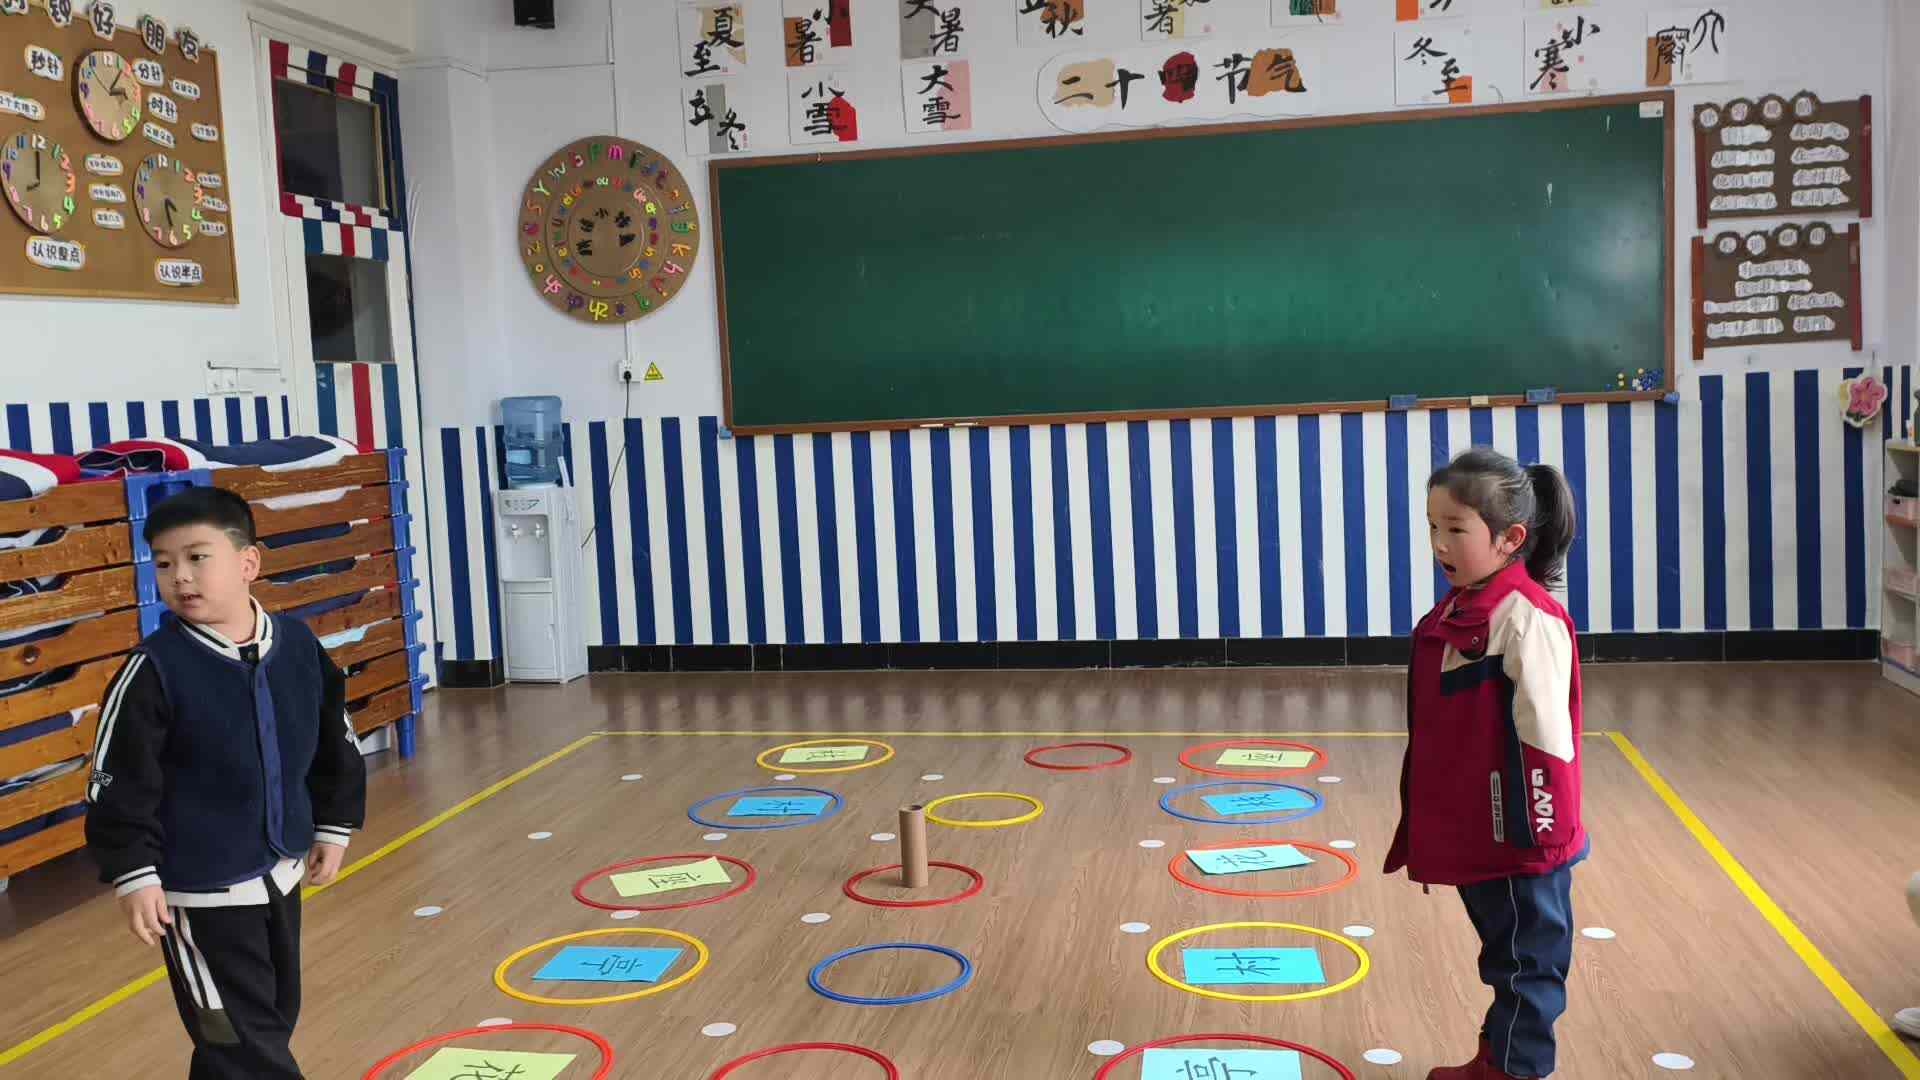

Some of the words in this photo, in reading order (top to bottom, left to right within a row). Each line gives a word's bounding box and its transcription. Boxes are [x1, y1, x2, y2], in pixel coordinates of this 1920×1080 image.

[684, 7, 745, 77] 夏至
[1530, 15, 1601, 91] 小寒
[30, 50, 60, 76] 秒针
[137, 62, 162, 80] 分针
[1403, 36, 1469, 95] 冬至
[917, 64, 962, 125] 大雪
[1053, 52, 1309, 112] 二十四节气
[151, 96, 176, 118] 时针
[800, 81, 850, 136] 小雪
[32, 241, 81, 264] 认识整点
[159, 265, 201, 280] 认识半点
[1215, 849, 1277, 868] 花
[647, 871, 702, 889] 座
[580, 954, 644, 976] 亭
[1214, 951, 1281, 977] 村
